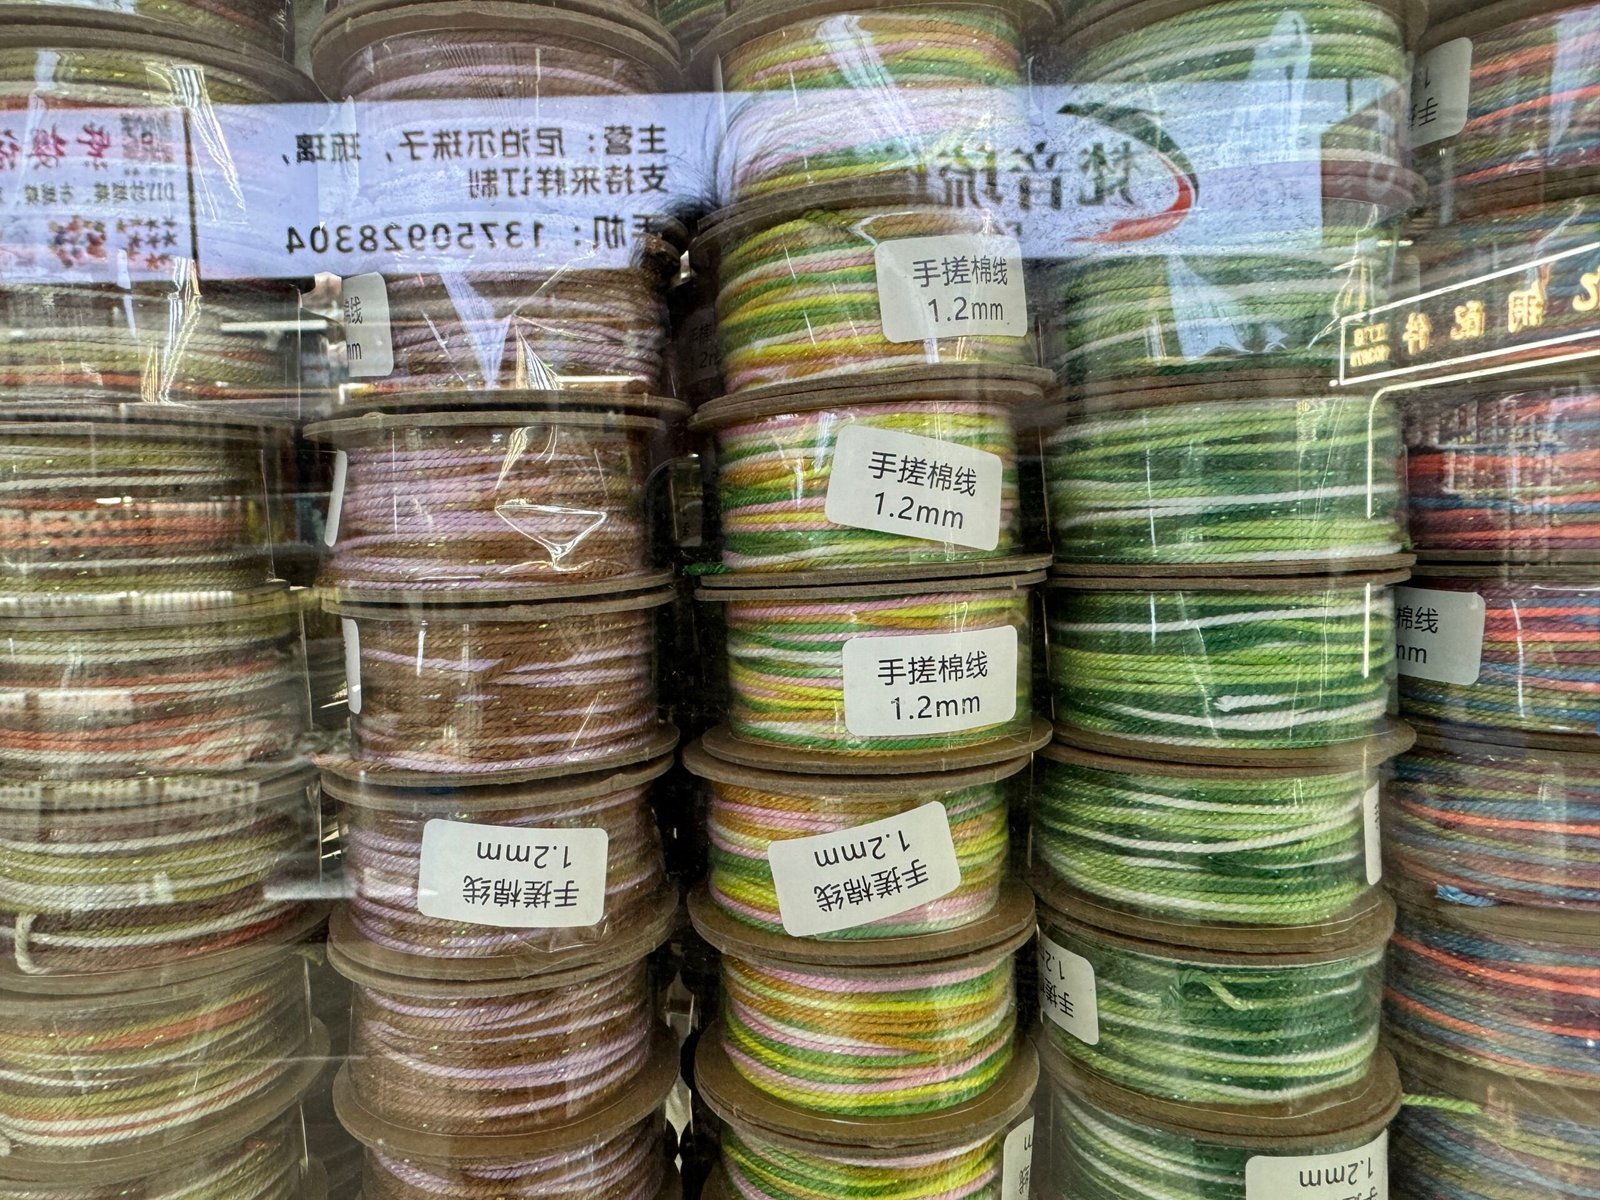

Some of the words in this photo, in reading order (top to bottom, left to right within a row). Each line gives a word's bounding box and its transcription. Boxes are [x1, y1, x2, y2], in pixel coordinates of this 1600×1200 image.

[912, 255, 1008, 288] 手搓棉线
[928, 296, 1004, 322] 1.2mm
[868, 451, 977, 496] 手搓棉线
[874, 492, 964, 529] 1.2mm
[877, 650, 988, 686] 手搓棉线
[890, 695, 981, 720] 1.2mm
[476, 841, 573, 869] 1.2mm
[814, 829, 911, 868] 1.2mm
[463, 875, 580, 908] 手搓棉线
[813, 858, 929, 913] 手搓棉线
[1299, 1156, 1374, 1188] 1.2mm
